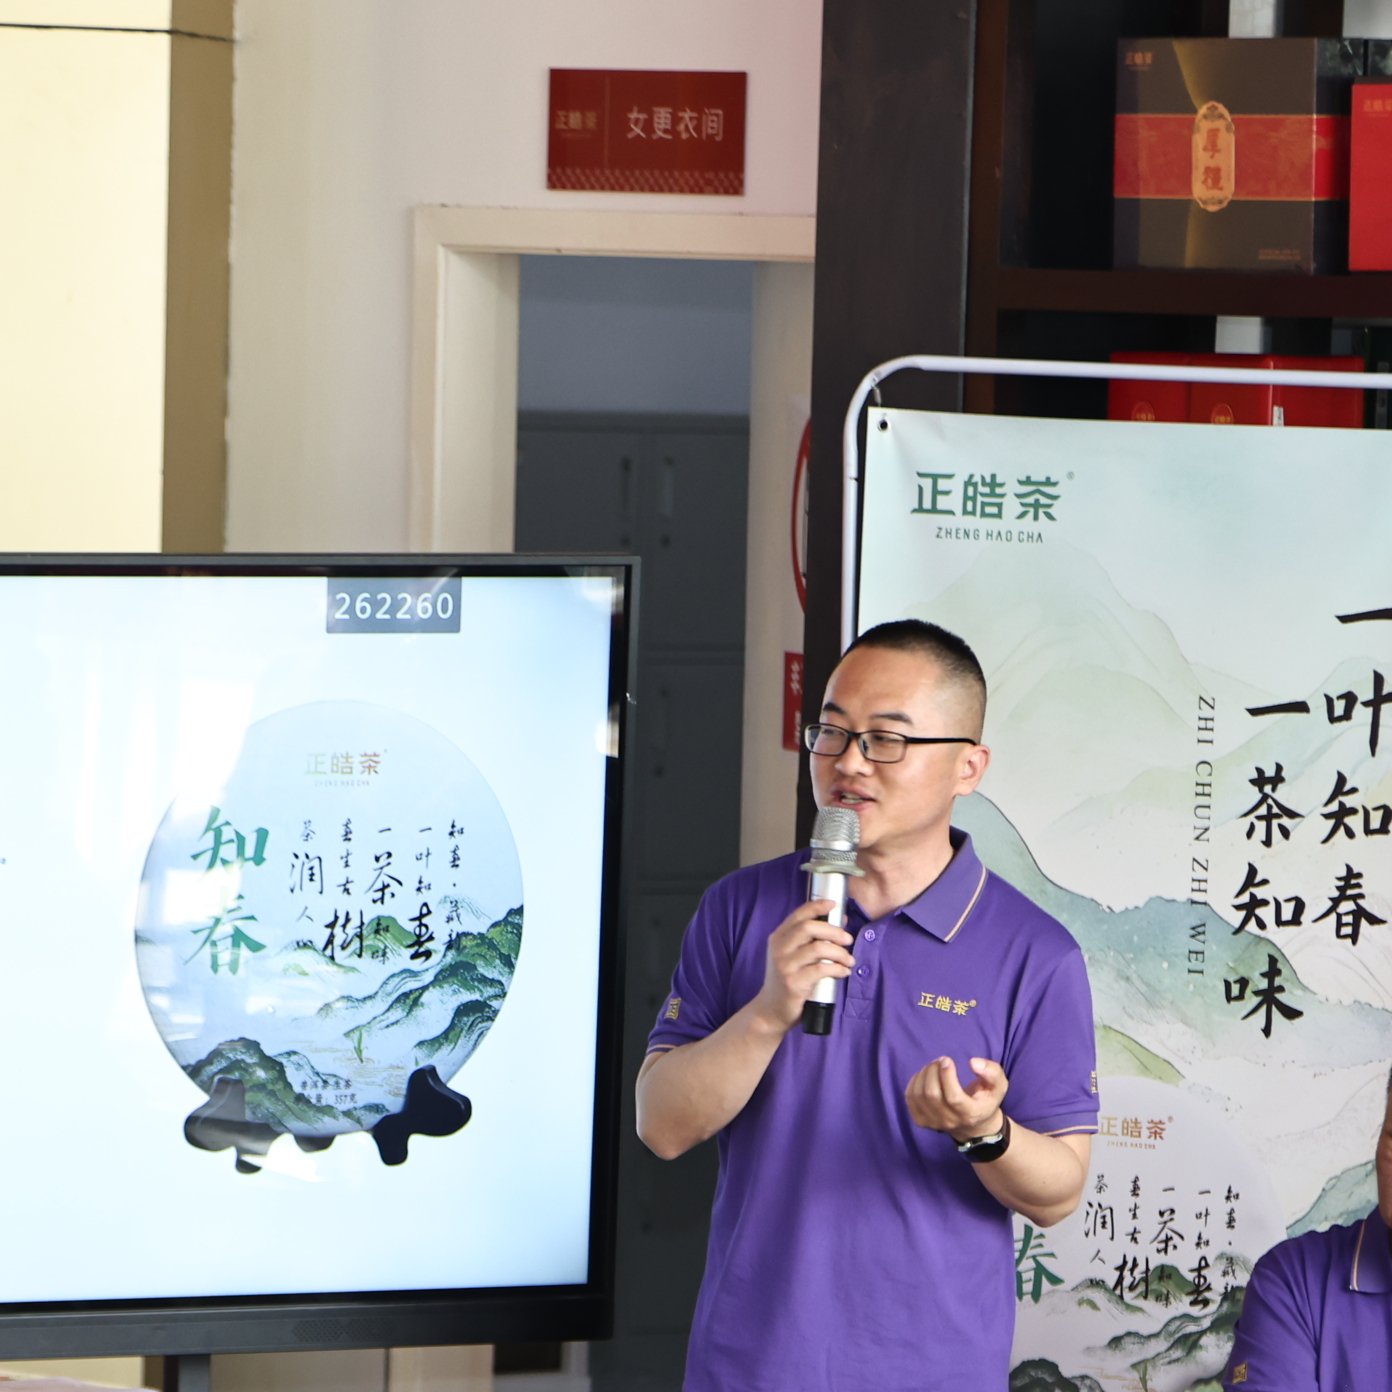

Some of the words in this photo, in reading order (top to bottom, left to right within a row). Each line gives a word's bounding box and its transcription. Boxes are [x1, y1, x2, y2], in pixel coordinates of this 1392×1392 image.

[626, 106, 724, 141] 女更衣间
[911, 471, 1061, 522] 正皓茶
[936, 526, 980, 541] ZHENG
[985, 529, 1013, 542] HAO
[1018, 530, 1044, 543] CHA
[333, 592, 455, 621] 262260
[1197, 696, 1216, 745] ZHI
[304, 751, 382, 775] 正皓茶
[1193, 760, 1214, 844] CHUN
[184, 805, 270, 976] 知春
[1190, 858, 1210, 908] ZHI
[1223, 699, 1311, 1039] 一茶知味
[1186, 924, 1207, 977] WEI
[918, 991, 970, 1016] 正皓茶
[1099, 1116, 1167, 1141] 正皓茶
[1014, 1223, 1065, 1305] 春
